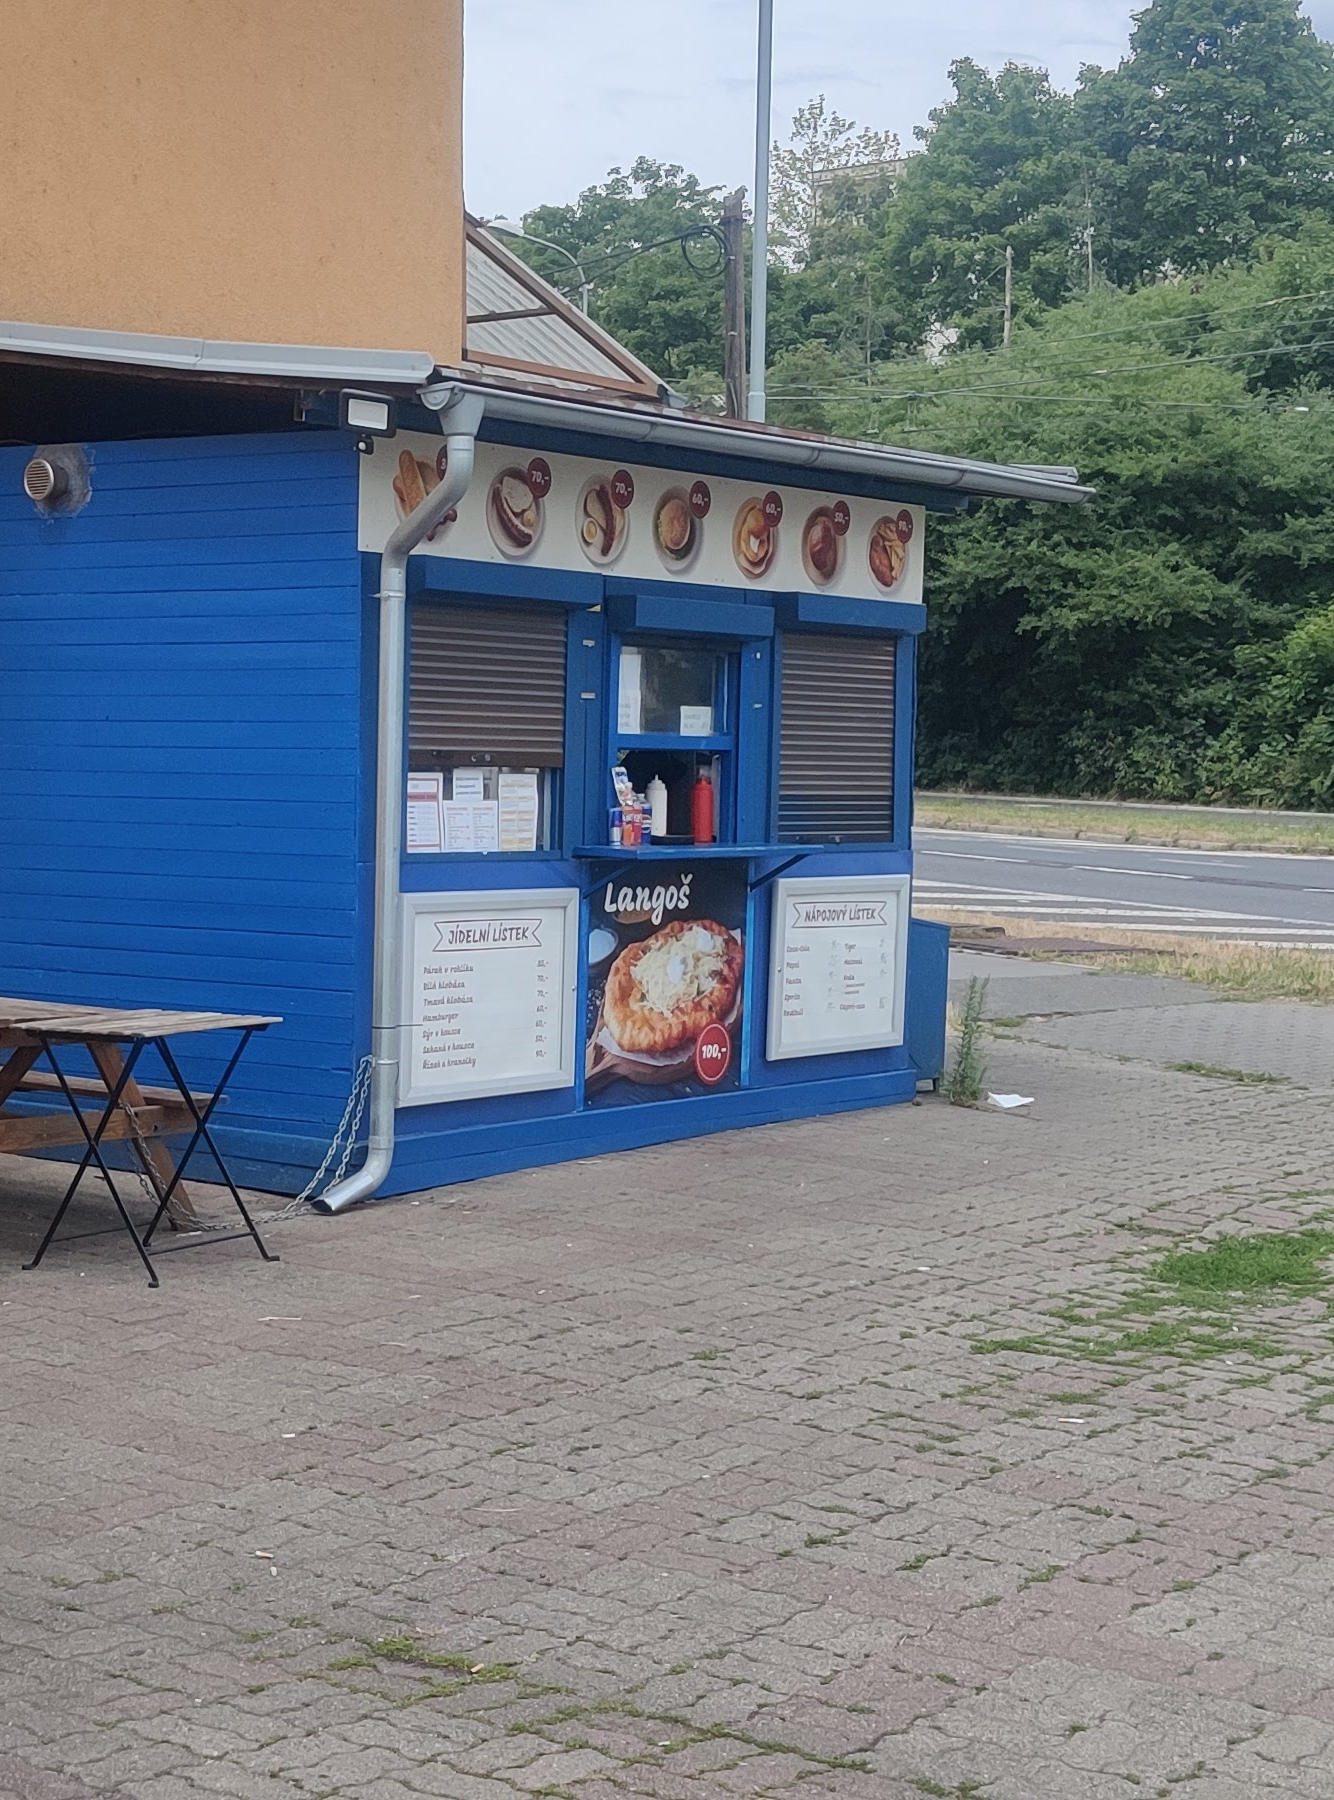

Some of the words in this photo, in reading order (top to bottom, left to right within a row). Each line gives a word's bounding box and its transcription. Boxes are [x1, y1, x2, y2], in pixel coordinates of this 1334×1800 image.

[531, 471, 549, 485] 70,-
[615, 482, 632, 495] 70,-
[692, 493, 709, 507] 60,-
[766, 503, 782, 516] 60,-
[834, 511, 849, 524] 50,-
[898, 520, 912, 533] 90,-
[604, 873, 694, 926] Langoš
[804, 904, 848, 923] NÁPOJOVÝ
[848, 904, 877, 921] LÍSTEK
[448, 923, 491, 945] JÍDELNÍ
[492, 922, 530, 943] LÍSTEK
[701, 1044, 727, 1060] 100,-
